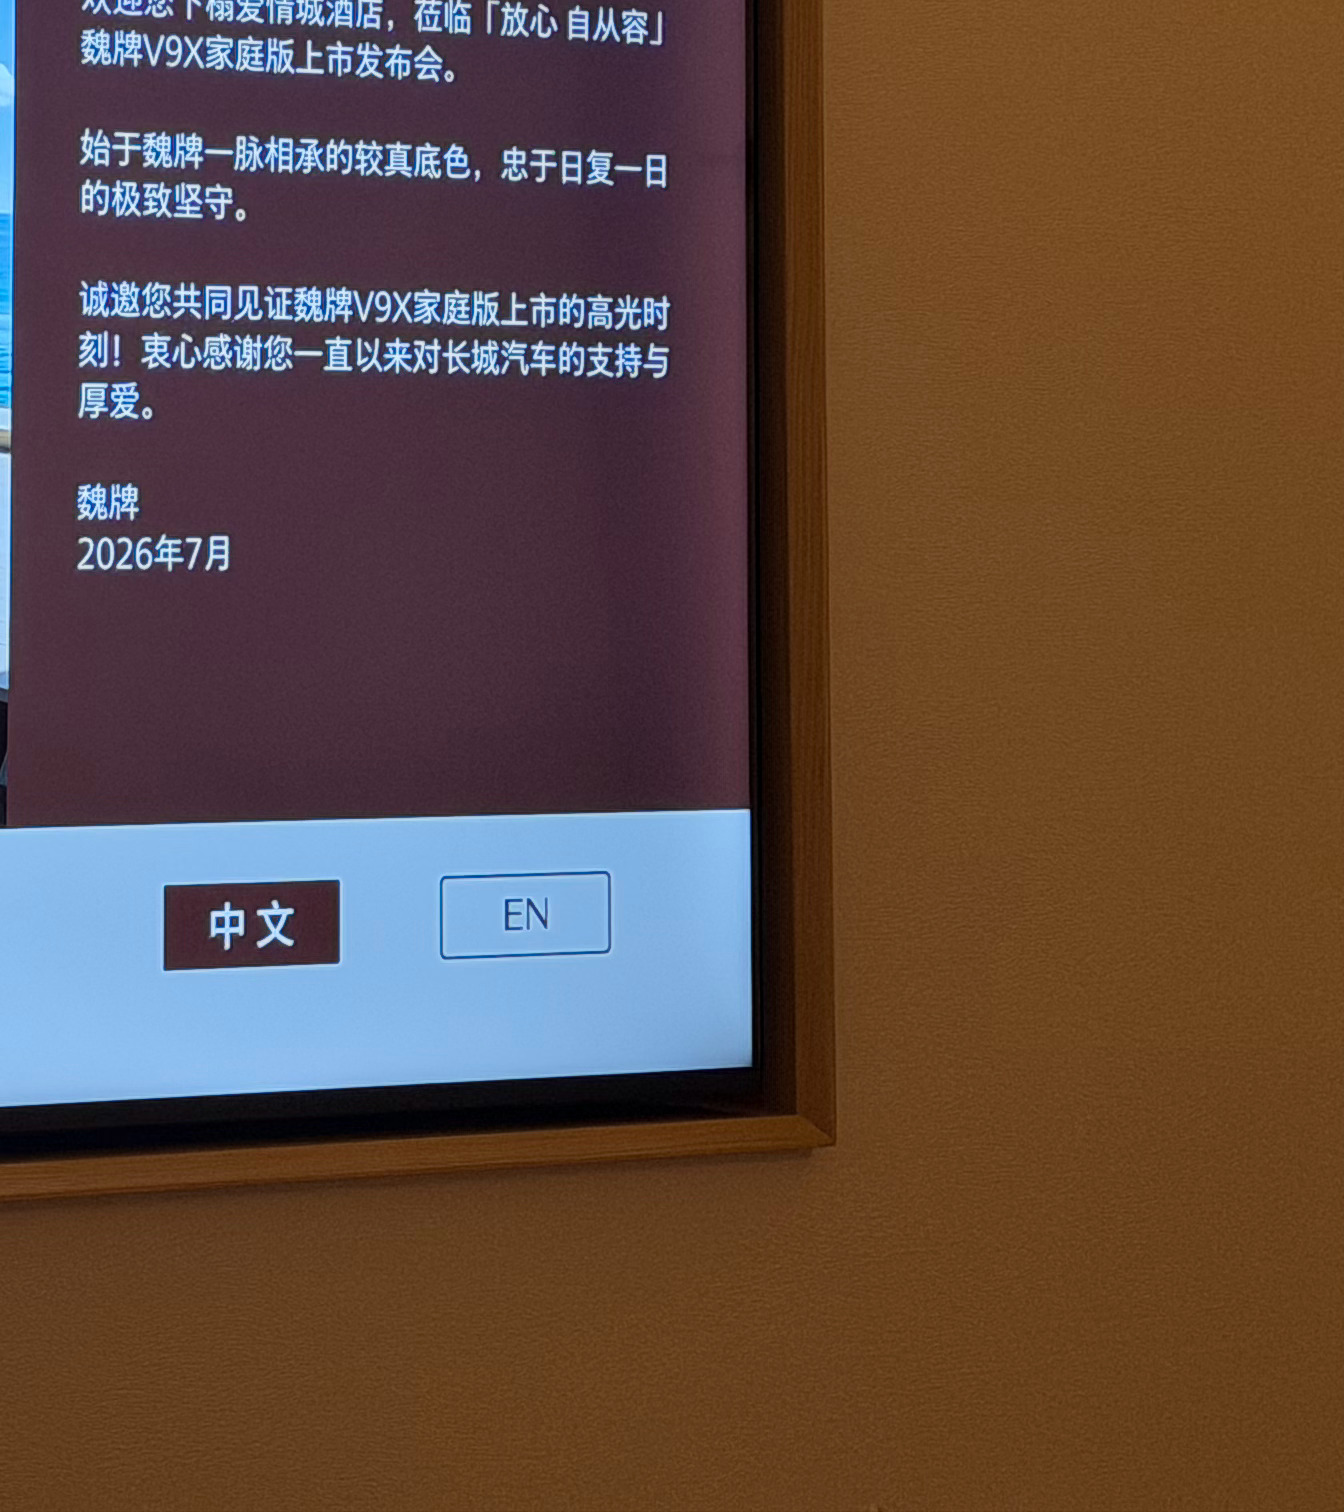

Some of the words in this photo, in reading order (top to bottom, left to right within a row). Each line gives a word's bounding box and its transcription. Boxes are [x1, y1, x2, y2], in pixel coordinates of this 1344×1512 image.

[80, 28, 455, 83] 魏牌V9X家庭版上市发布会。
[80, 128, 667, 189] 始于魏牌一脉相承的较真底色，忠于日复一日
[81, 180, 247, 222] 的极致坚守。
[78, 279, 671, 331] 诚邀您共同见证魏牌V9X家庭版上市的高光时
[78, 331, 670, 379] 刻！衷心感谢您一直以来对长城汽车的支持与
[77, 382, 154, 420] 厚爱。
[77, 482, 140, 521] 魏牌
[76, 534, 230, 572] 2026年7月
[210, 899, 294, 950] 中文
[504, 896, 550, 932] EN
